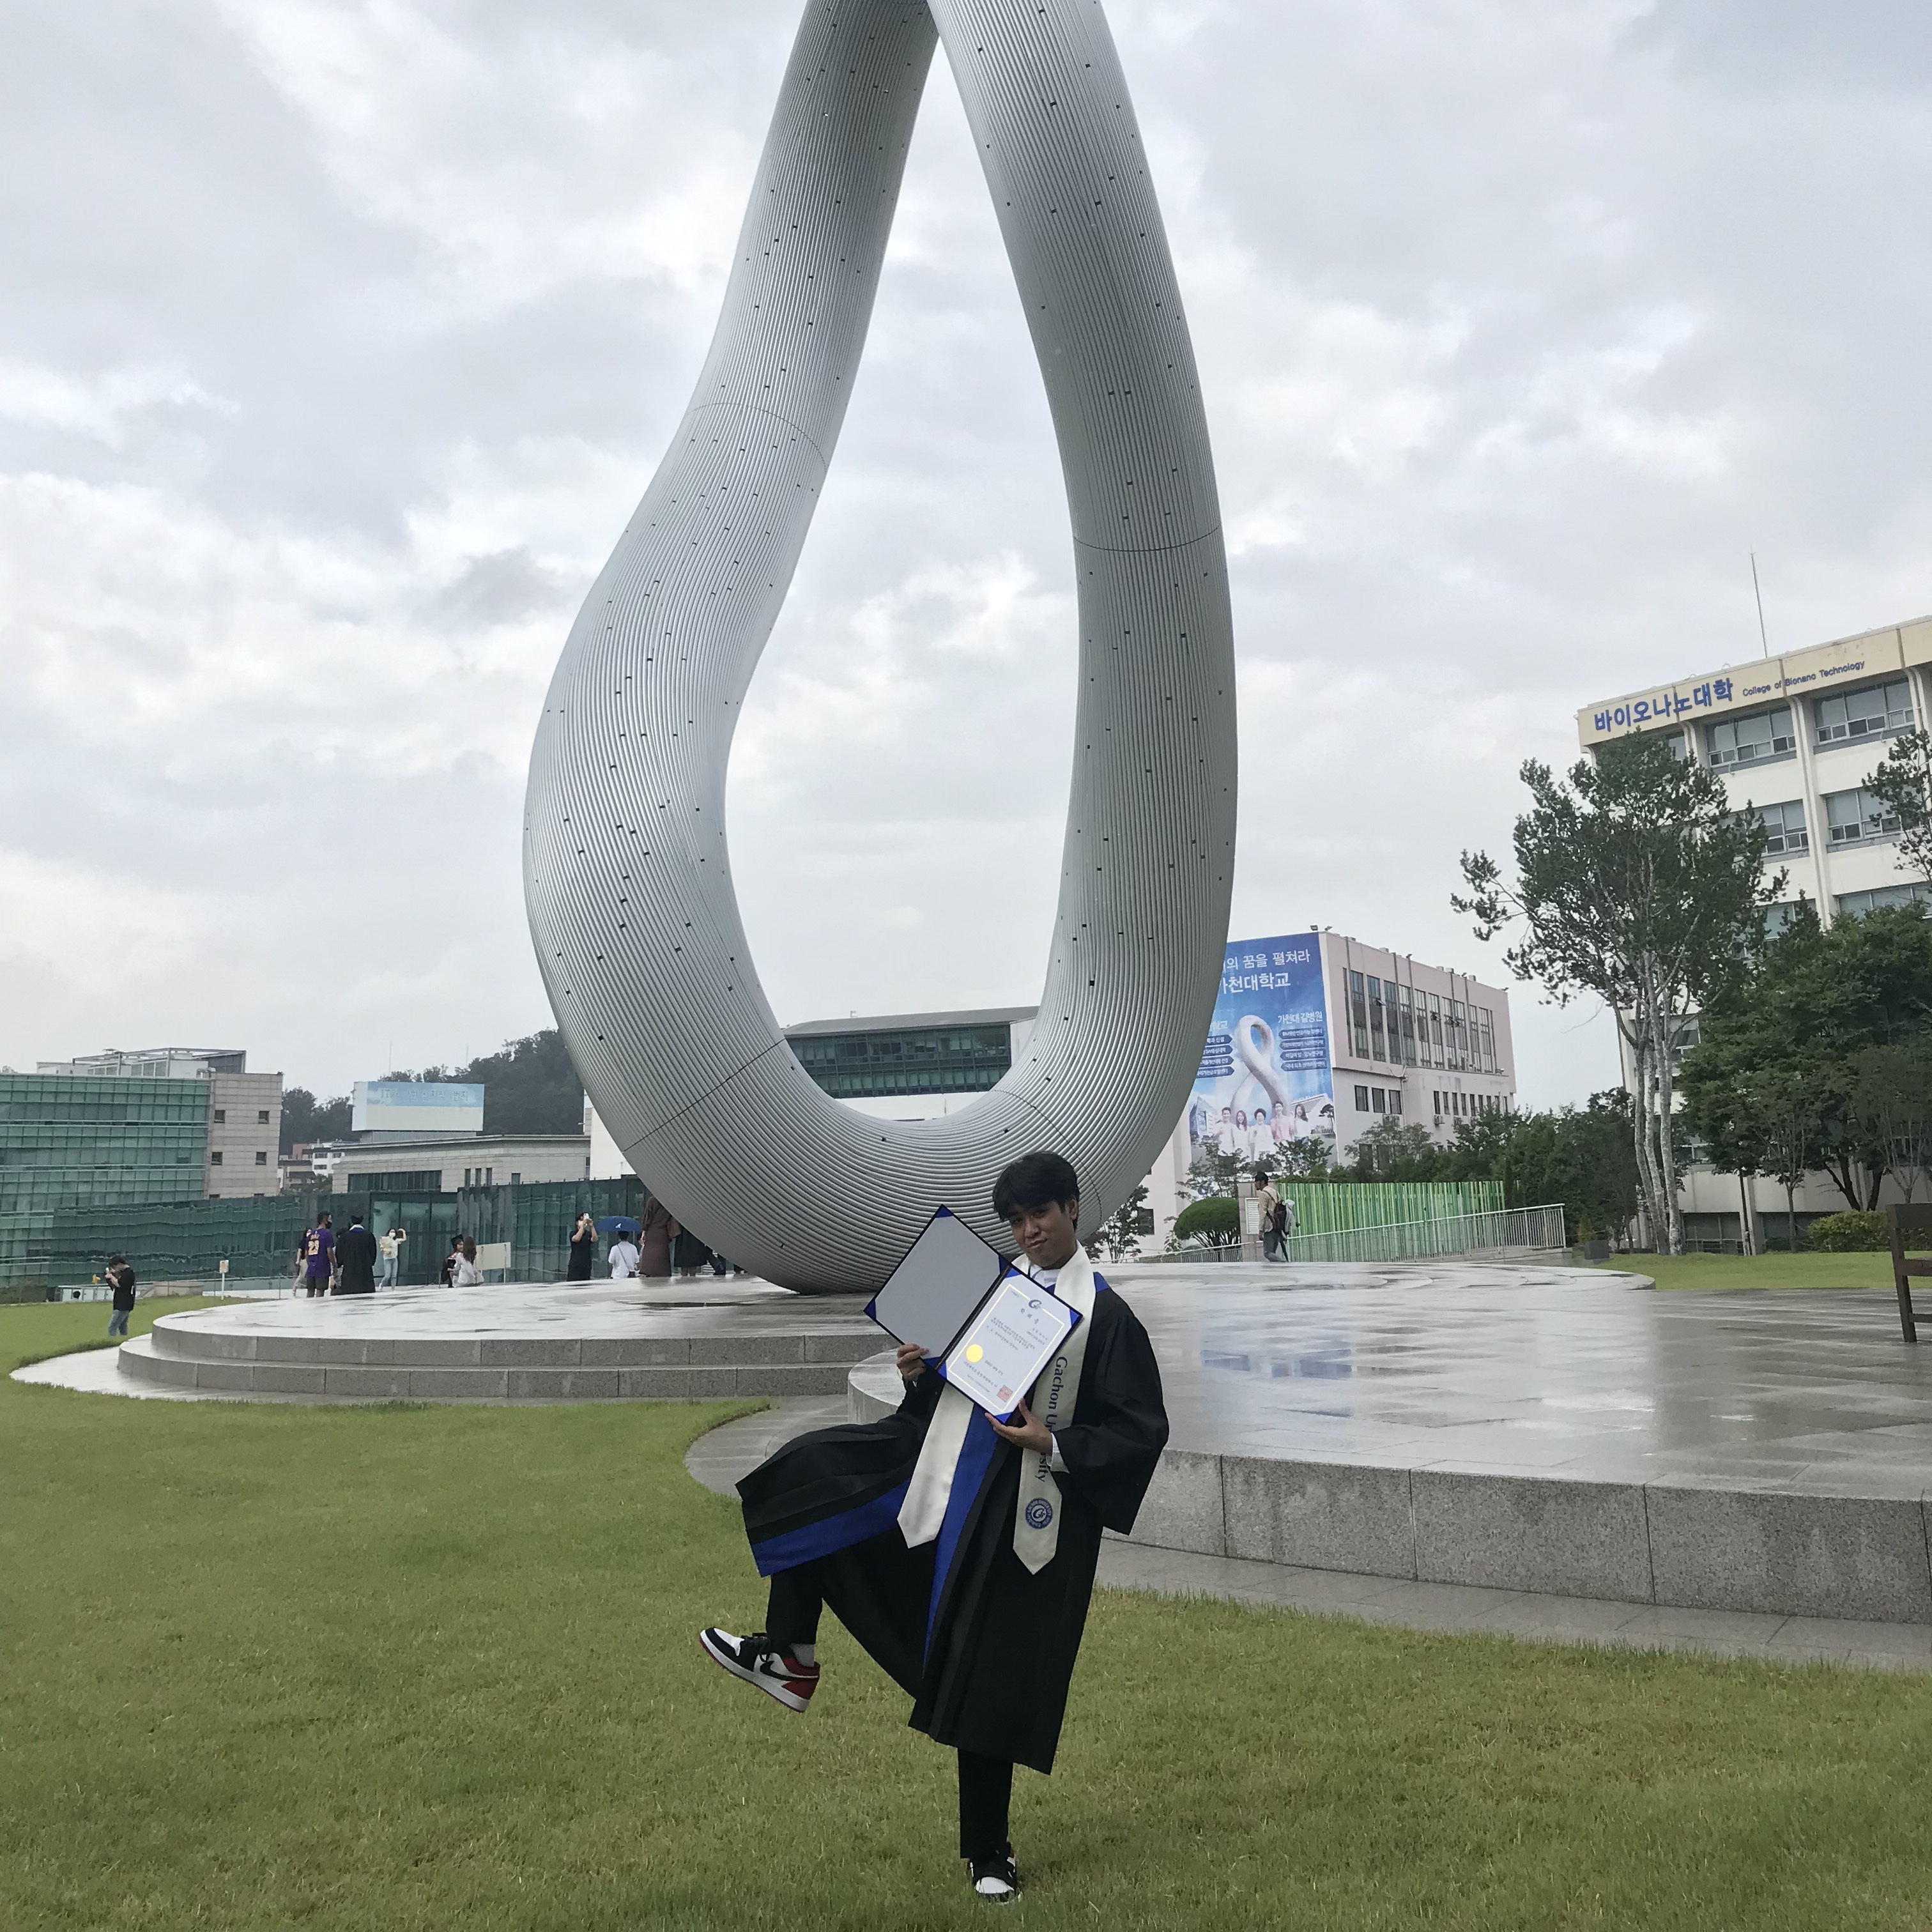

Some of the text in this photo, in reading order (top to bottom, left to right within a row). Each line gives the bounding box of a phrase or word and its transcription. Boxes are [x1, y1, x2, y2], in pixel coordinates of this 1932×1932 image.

[1742, 661, 1865, 697] College of Bionano Technology
[1594, 677, 1733, 732] 바이오나노대학
[1243, 953, 1268, 969] 꿈을
[1272, 949, 1311, 966] 펼쳐라
[1278, 1011, 1322, 1024] 가천대 길병원
[1048, 1356, 1068, 1410] Gachon
